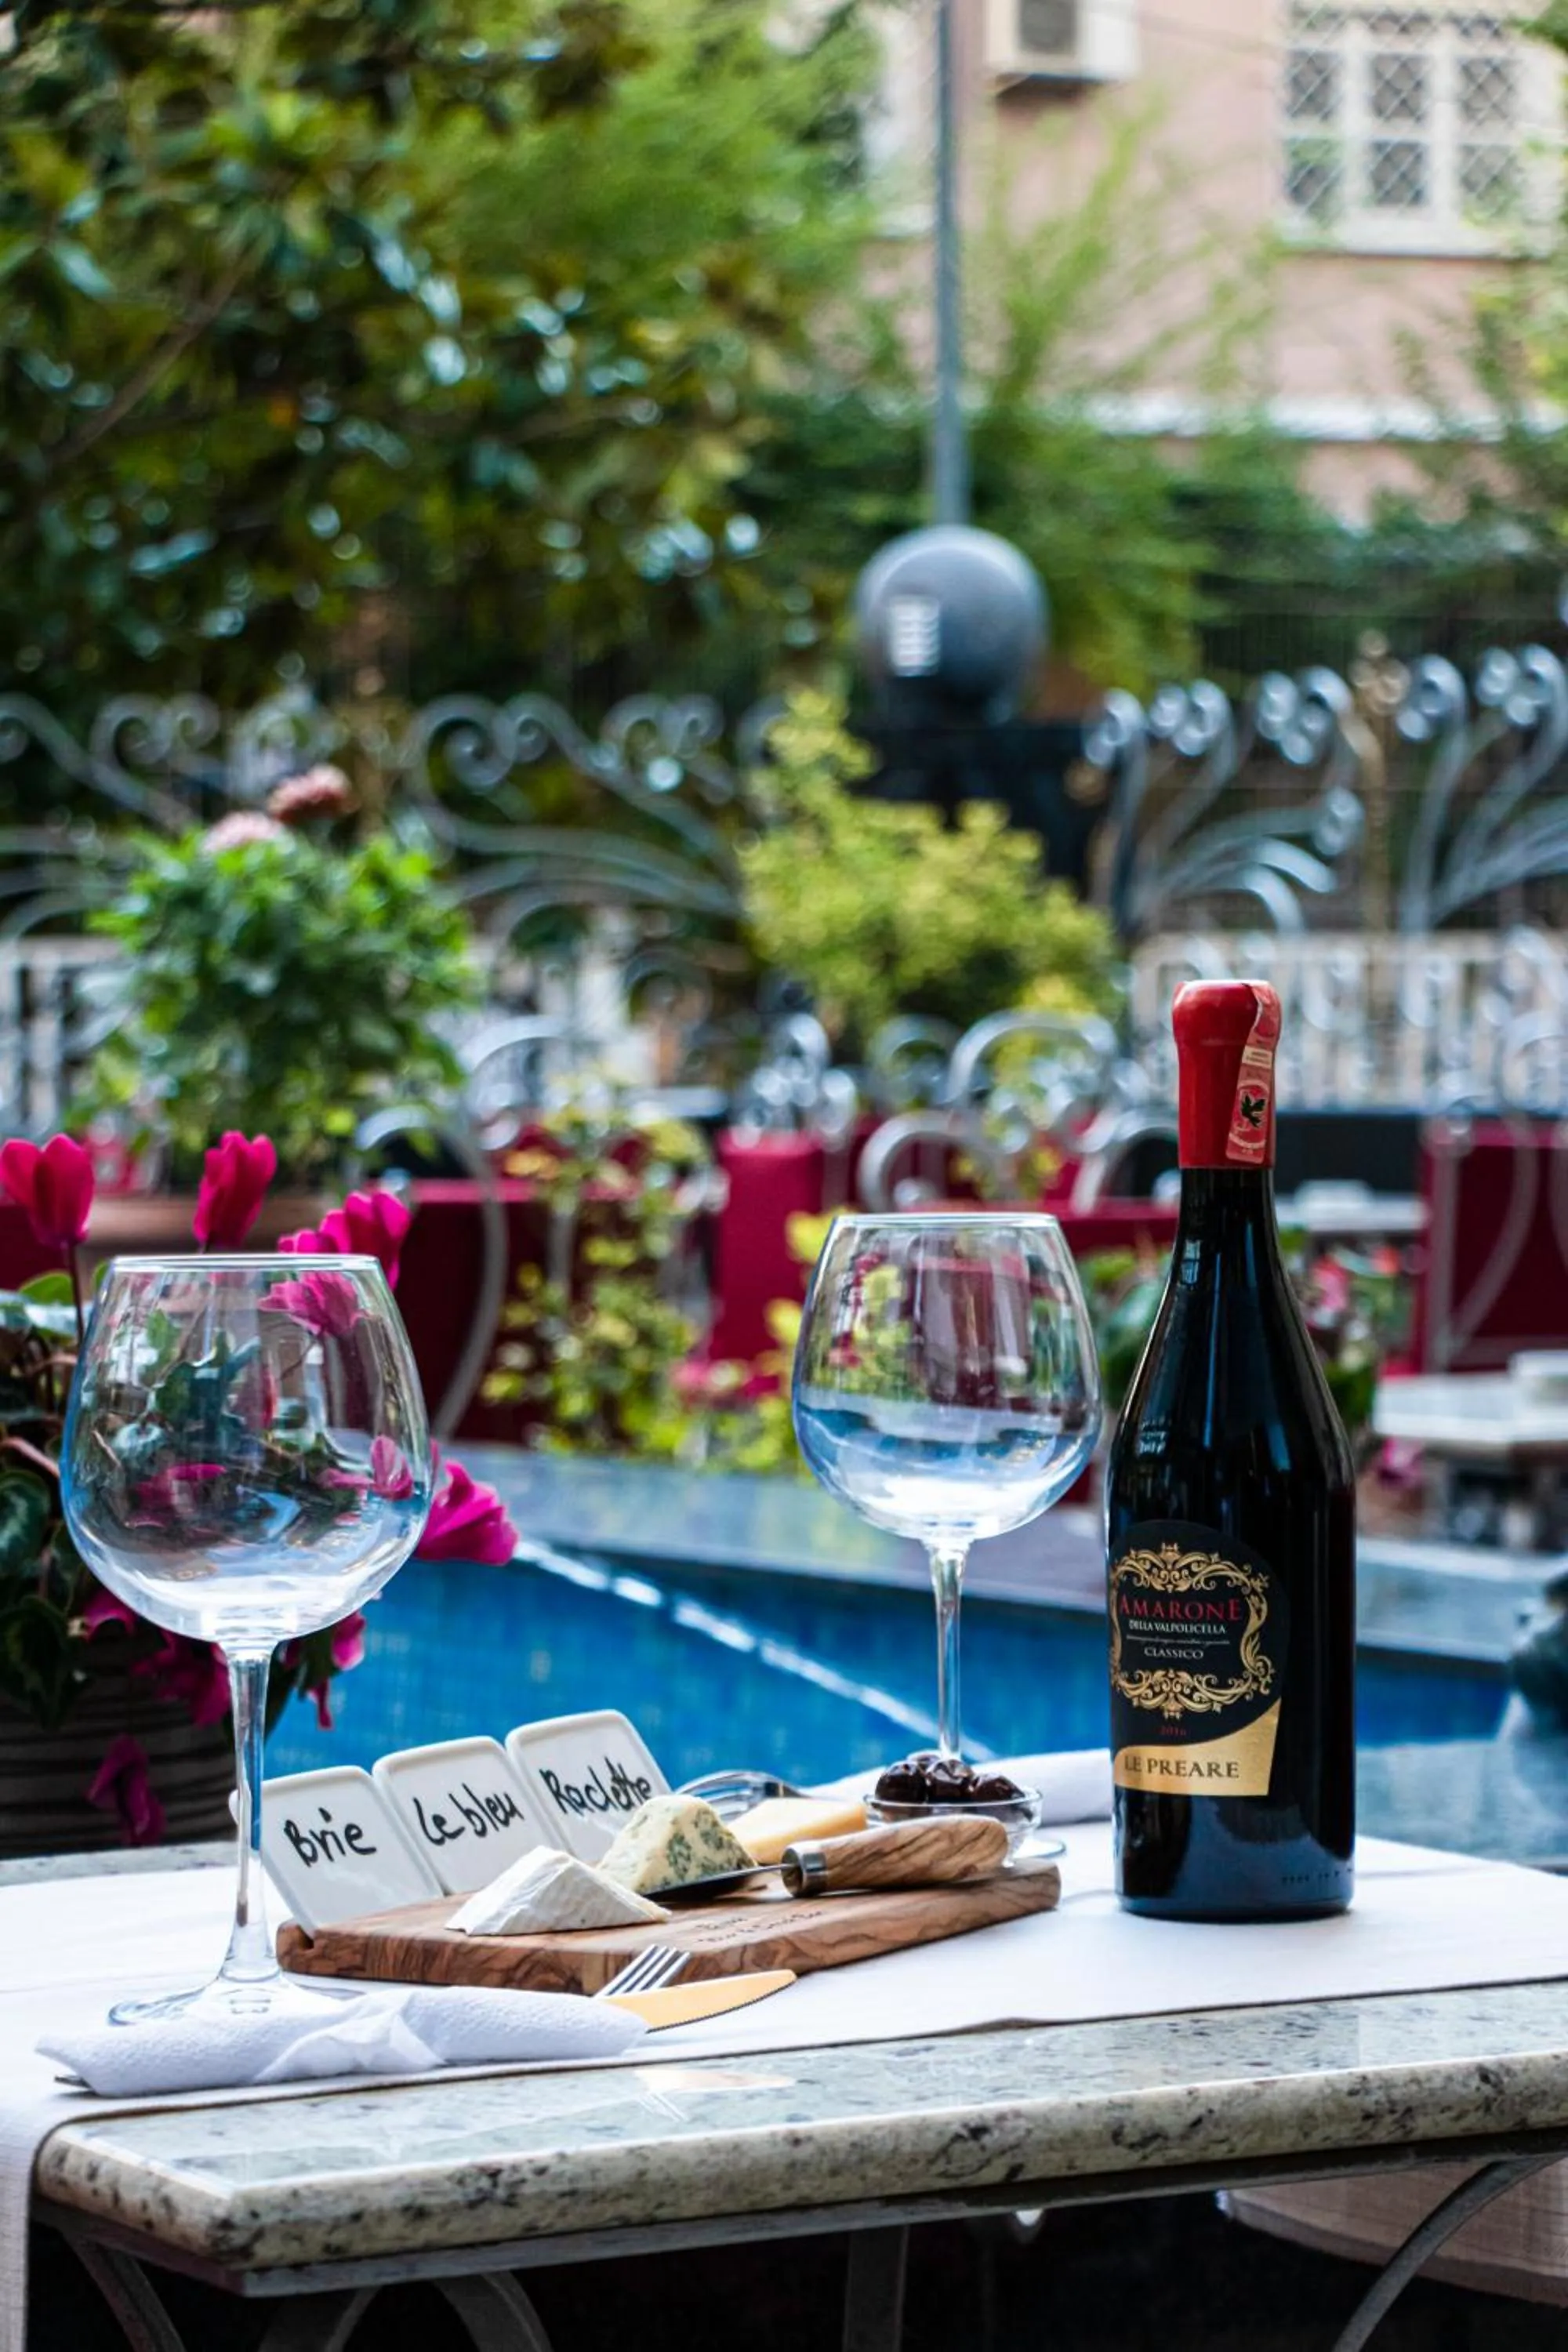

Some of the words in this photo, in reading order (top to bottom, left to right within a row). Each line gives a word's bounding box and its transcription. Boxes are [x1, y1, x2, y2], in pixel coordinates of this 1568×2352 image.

[1120, 1594, 1241, 1621] AMARONE
[1129, 1619, 1153, 1631] DELLA
[1153, 1621, 1226, 1634] VALPOLICELLA
[1144, 1646, 1204, 1660] CLASSICO
[1124, 1755, 1142, 1773] LE
[1147, 1759, 1239, 1778] PREARE
[539, 1755, 652, 1817] Raclette
[413, 1797, 463, 1846] Le
[461, 1783, 524, 1838] bleu
[284, 1807, 376, 1867] Brie
